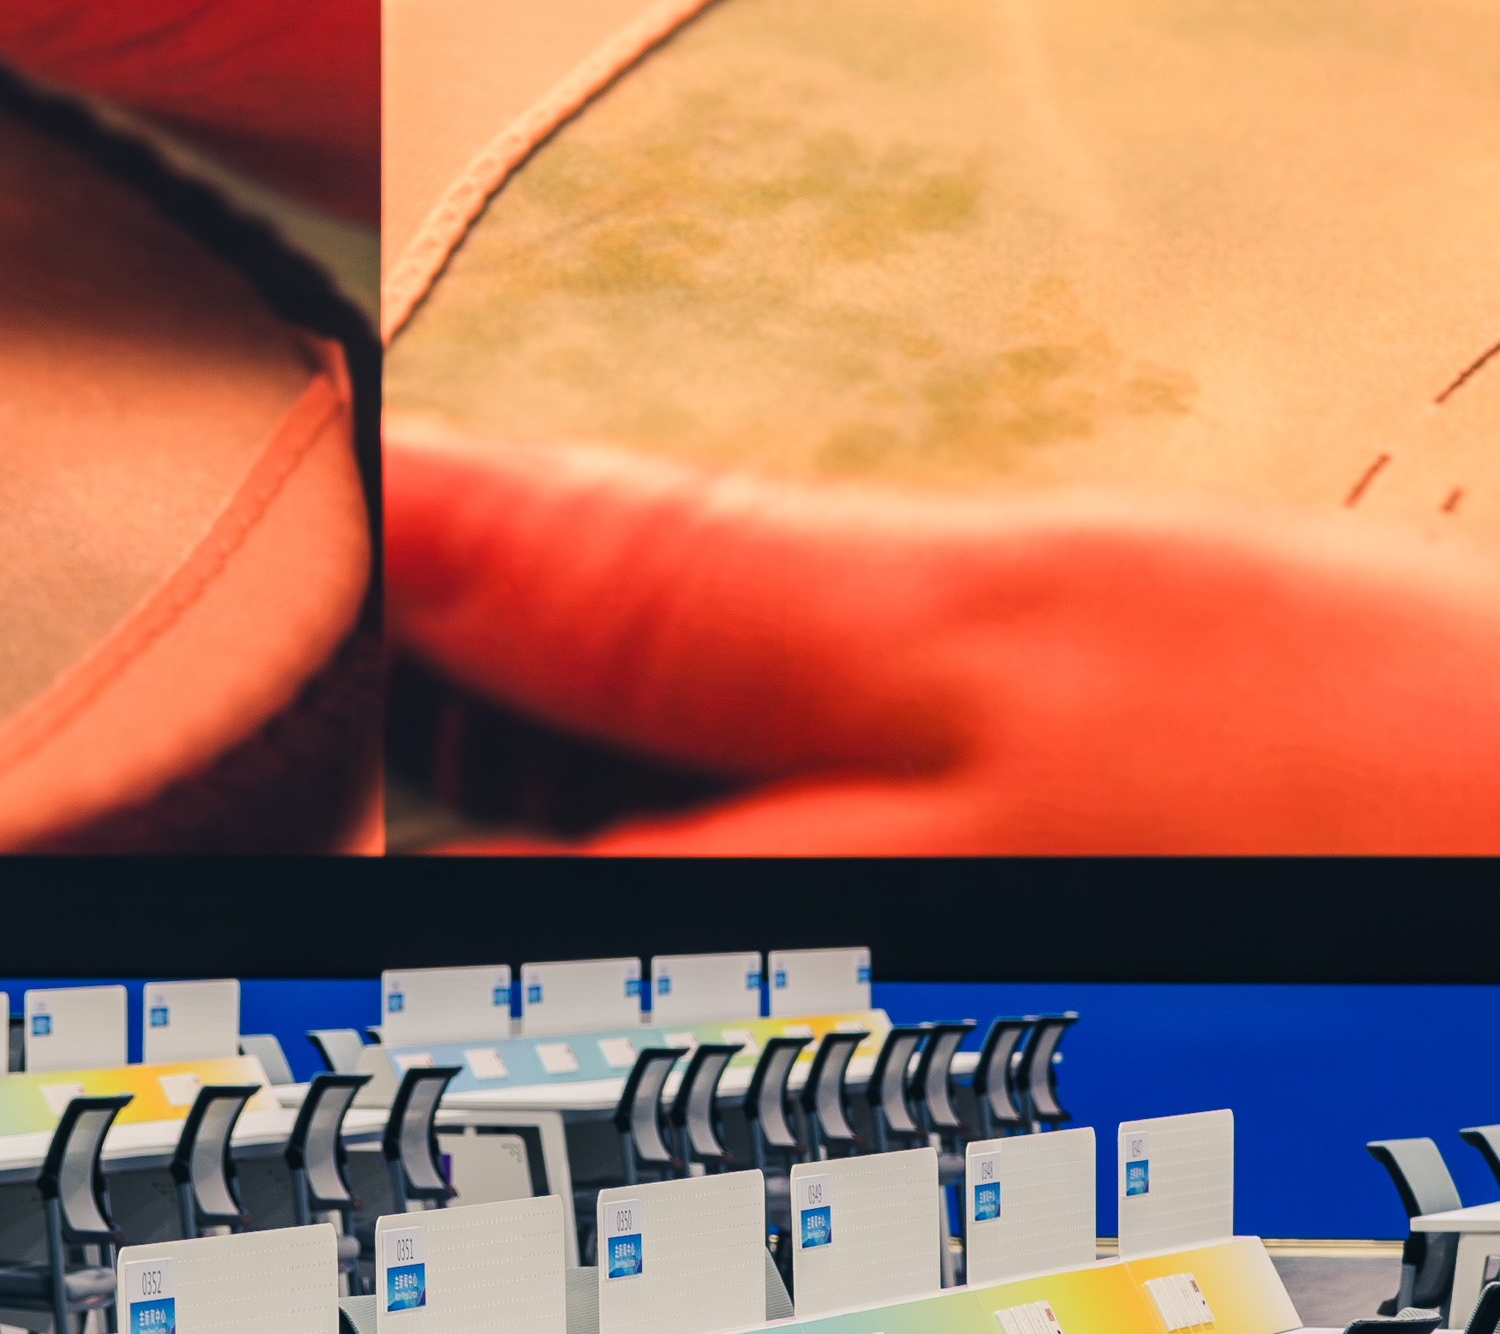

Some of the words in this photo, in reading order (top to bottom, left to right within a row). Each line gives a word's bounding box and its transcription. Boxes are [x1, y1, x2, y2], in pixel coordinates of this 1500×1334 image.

[616, 1209, 633, 1232] 0350
[396, 1238, 414, 1261] 0351
[141, 1270, 162, 1295] 0352
